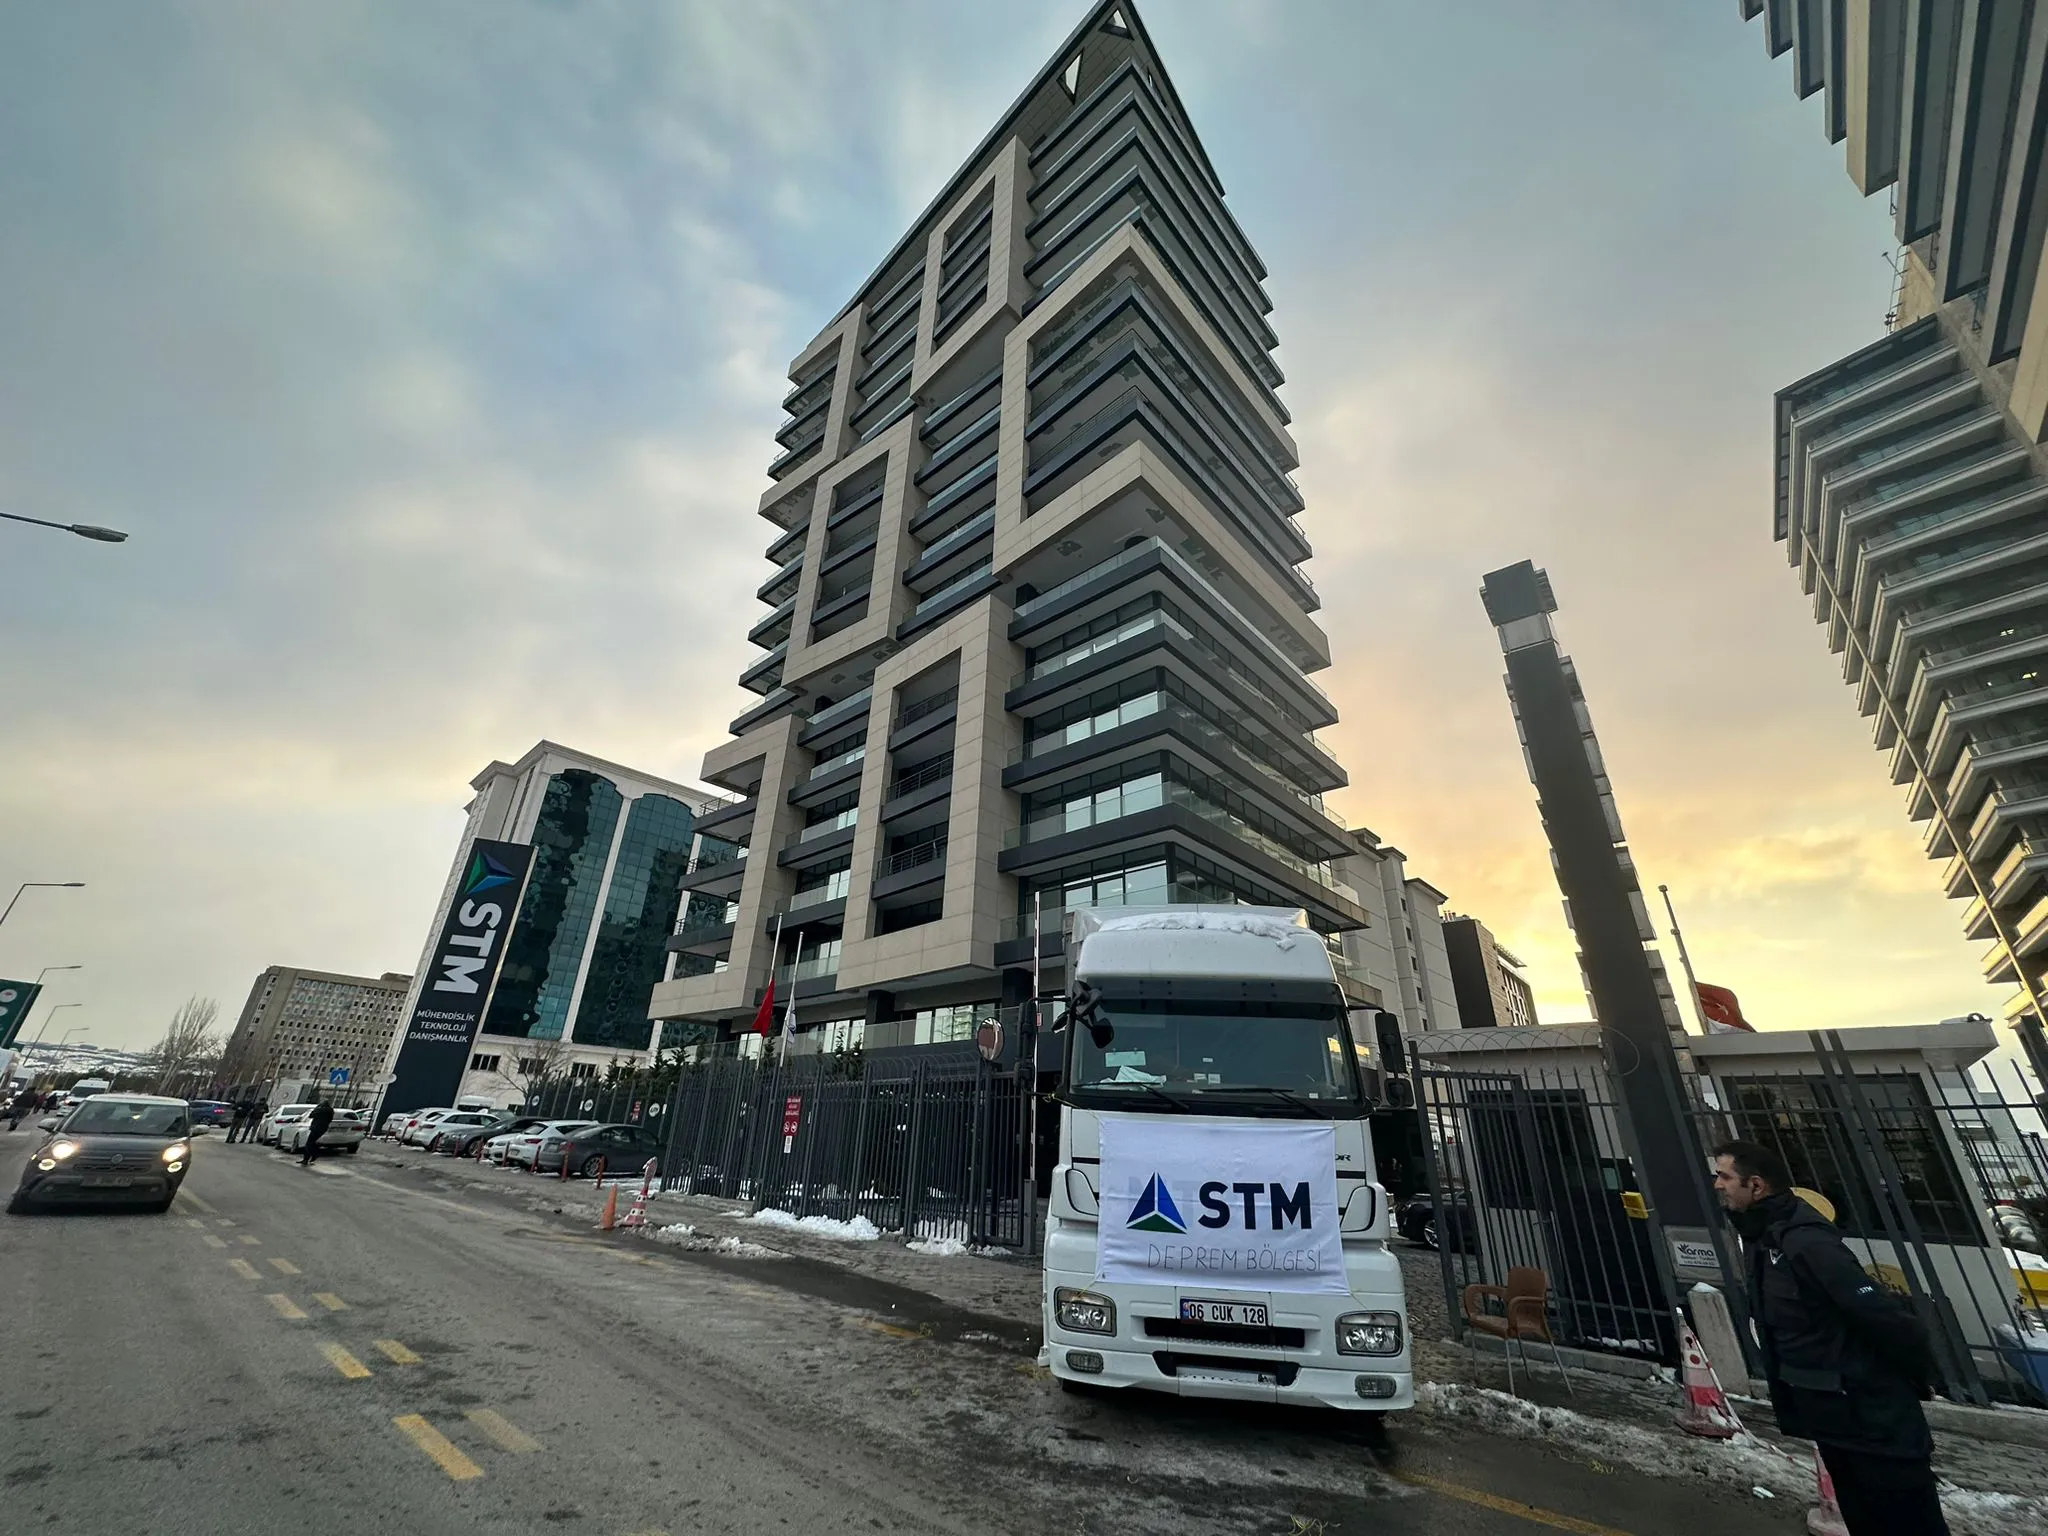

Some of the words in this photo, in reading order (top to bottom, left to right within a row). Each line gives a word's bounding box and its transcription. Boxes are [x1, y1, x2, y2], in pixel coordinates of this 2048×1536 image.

[433, 898, 502, 994] STM
[416, 1009, 476, 1022] MÜHENDİSLİK
[420, 1020, 467, 1032] TEKNOLOJİ
[409, 1031, 469, 1044] DANIŞMANLIK
[1197, 1181, 1313, 1230] STM
[1147, 1243, 1238, 1271] DEPREM
[1246, 1243, 1322, 1272] BÖLGESİ
[1189, 1303, 1204, 1319] 06
[1211, 1304, 1235, 1322] CUK
[1242, 1307, 1265, 1324] 128
